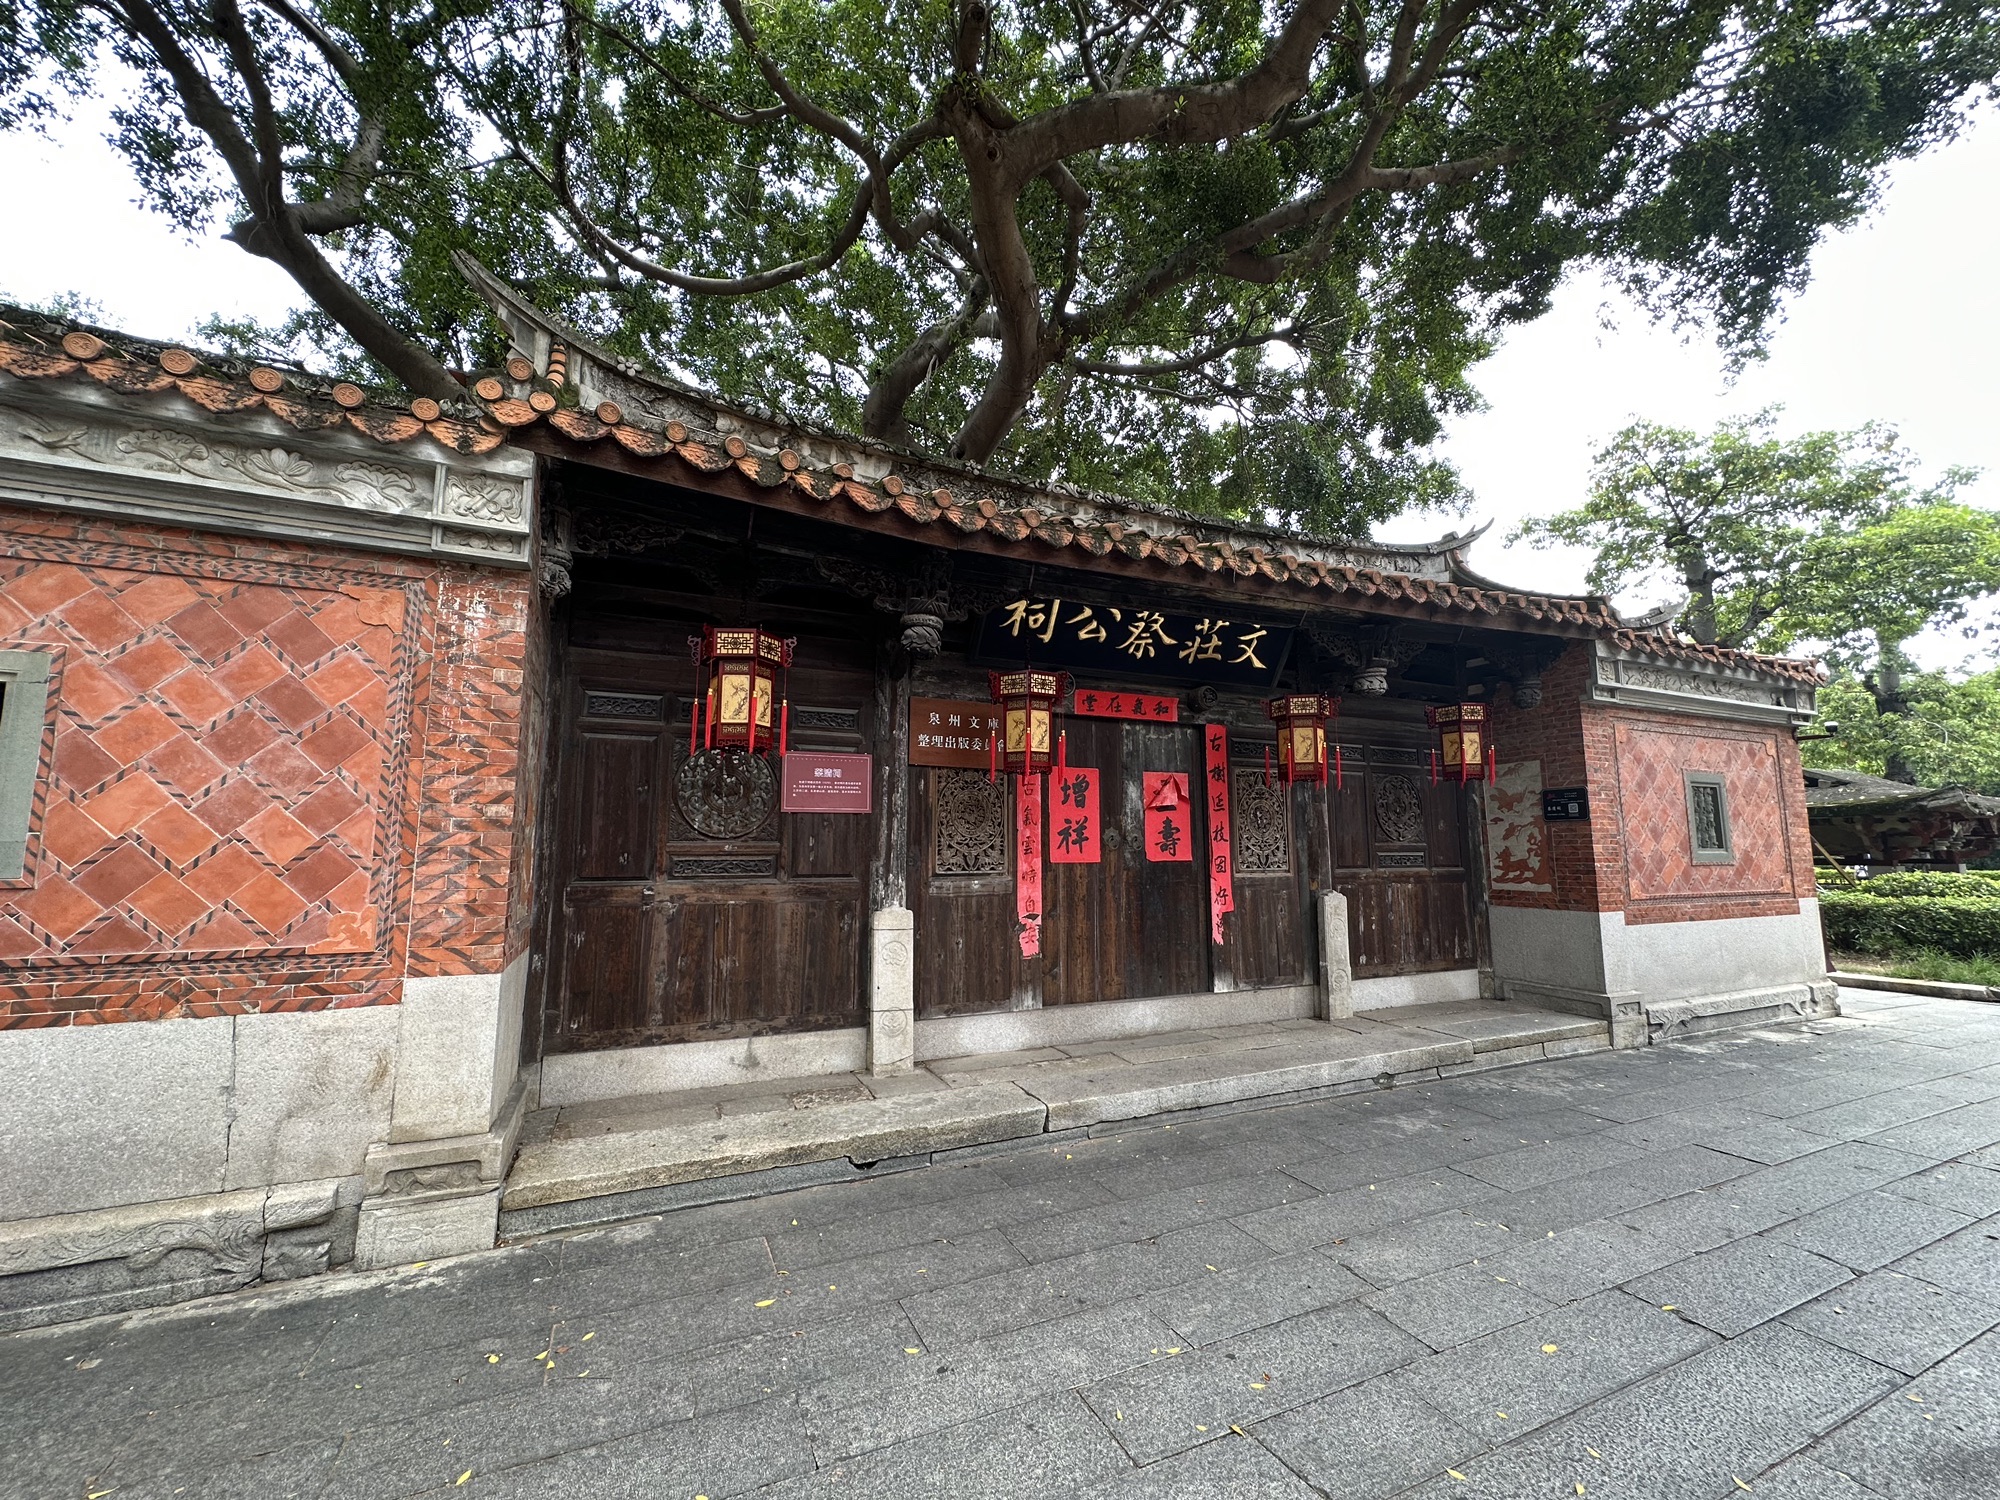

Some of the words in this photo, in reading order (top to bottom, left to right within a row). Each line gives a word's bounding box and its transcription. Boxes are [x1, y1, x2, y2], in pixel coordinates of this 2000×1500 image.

[928, 712, 999, 729] 泉州文庫
[1057, 774, 1089, 854] 增祥
